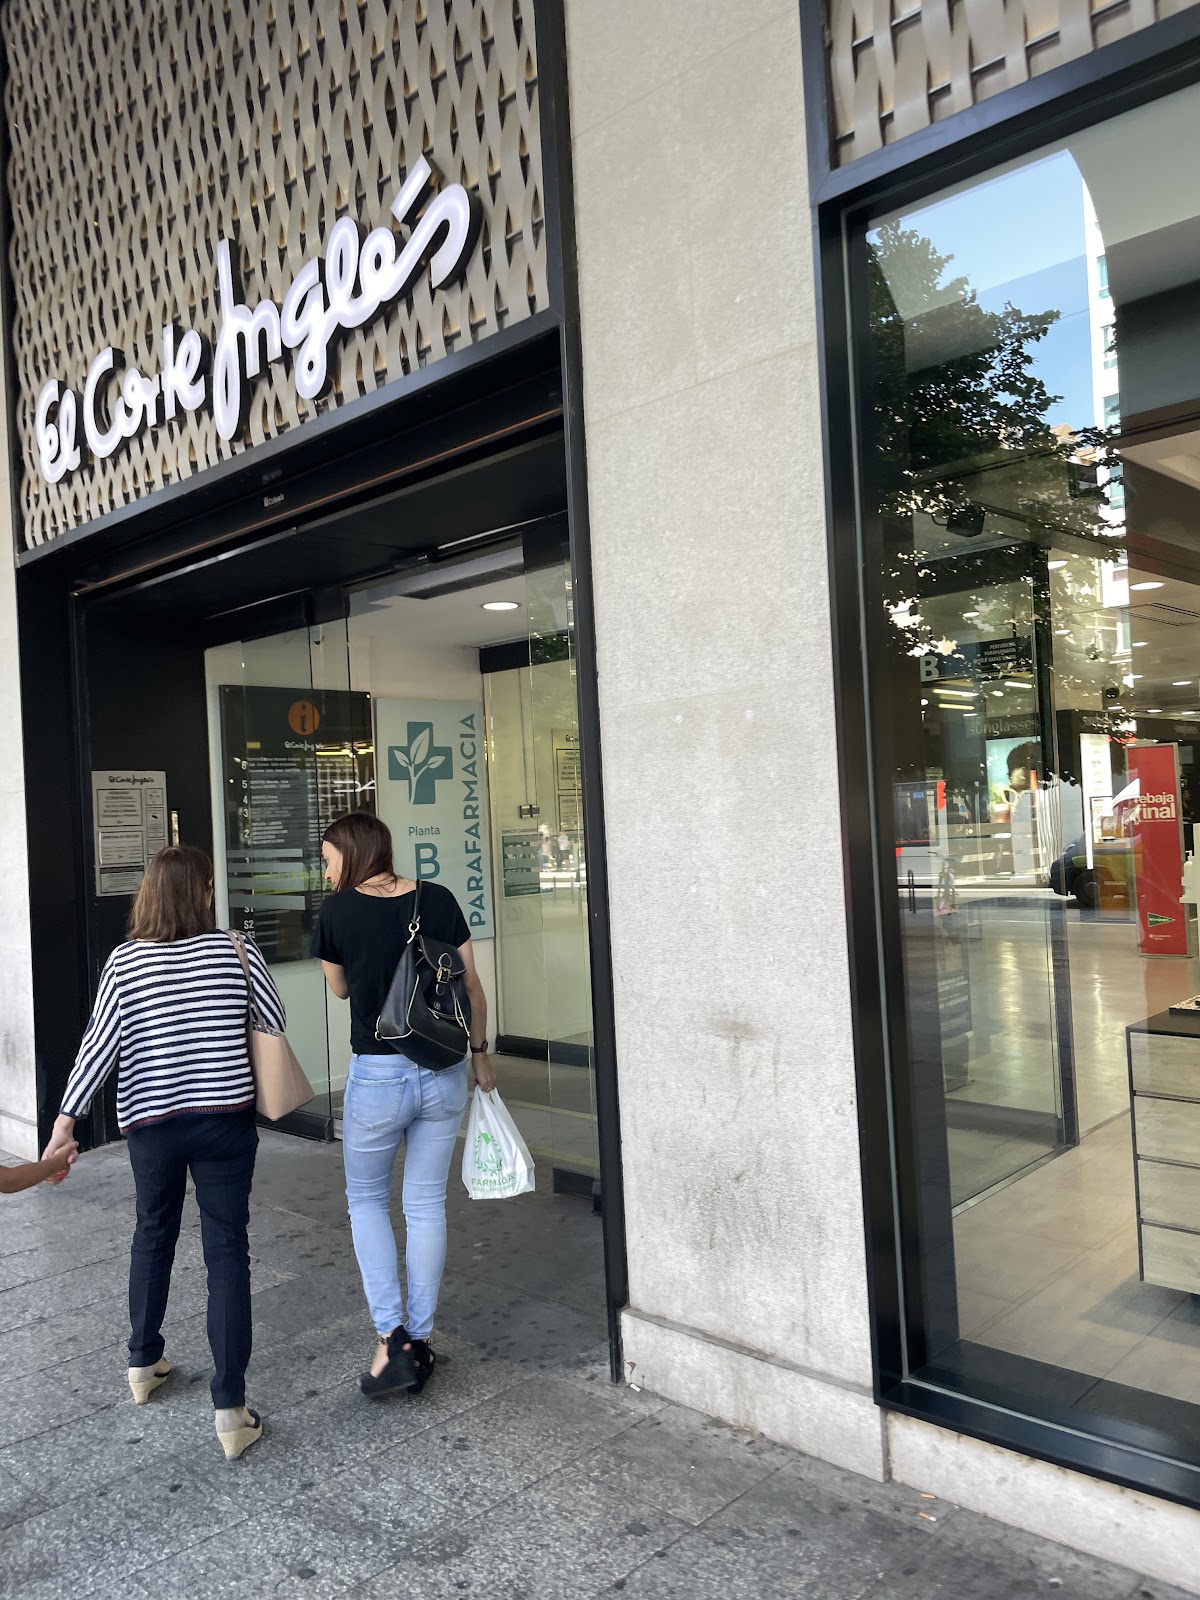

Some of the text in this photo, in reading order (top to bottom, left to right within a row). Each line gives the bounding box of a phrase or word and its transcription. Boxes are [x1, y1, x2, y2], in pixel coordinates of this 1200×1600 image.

[35, 154, 474, 484] El Corte Inglés
[920, 655, 939, 682] B
[968, 717, 1039, 737] sunglasses
[241, 760, 248, 770] 6
[241, 779, 248, 789] 5
[242, 795, 249, 804] 4
[243, 808, 249, 818] 3
[459, 713, 486, 927] PARAFARMACIA
[244, 829, 250, 838] 2
[408, 826, 441, 837] Planta
[415, 842, 440, 881] B
[243, 919, 255, 930] S2
